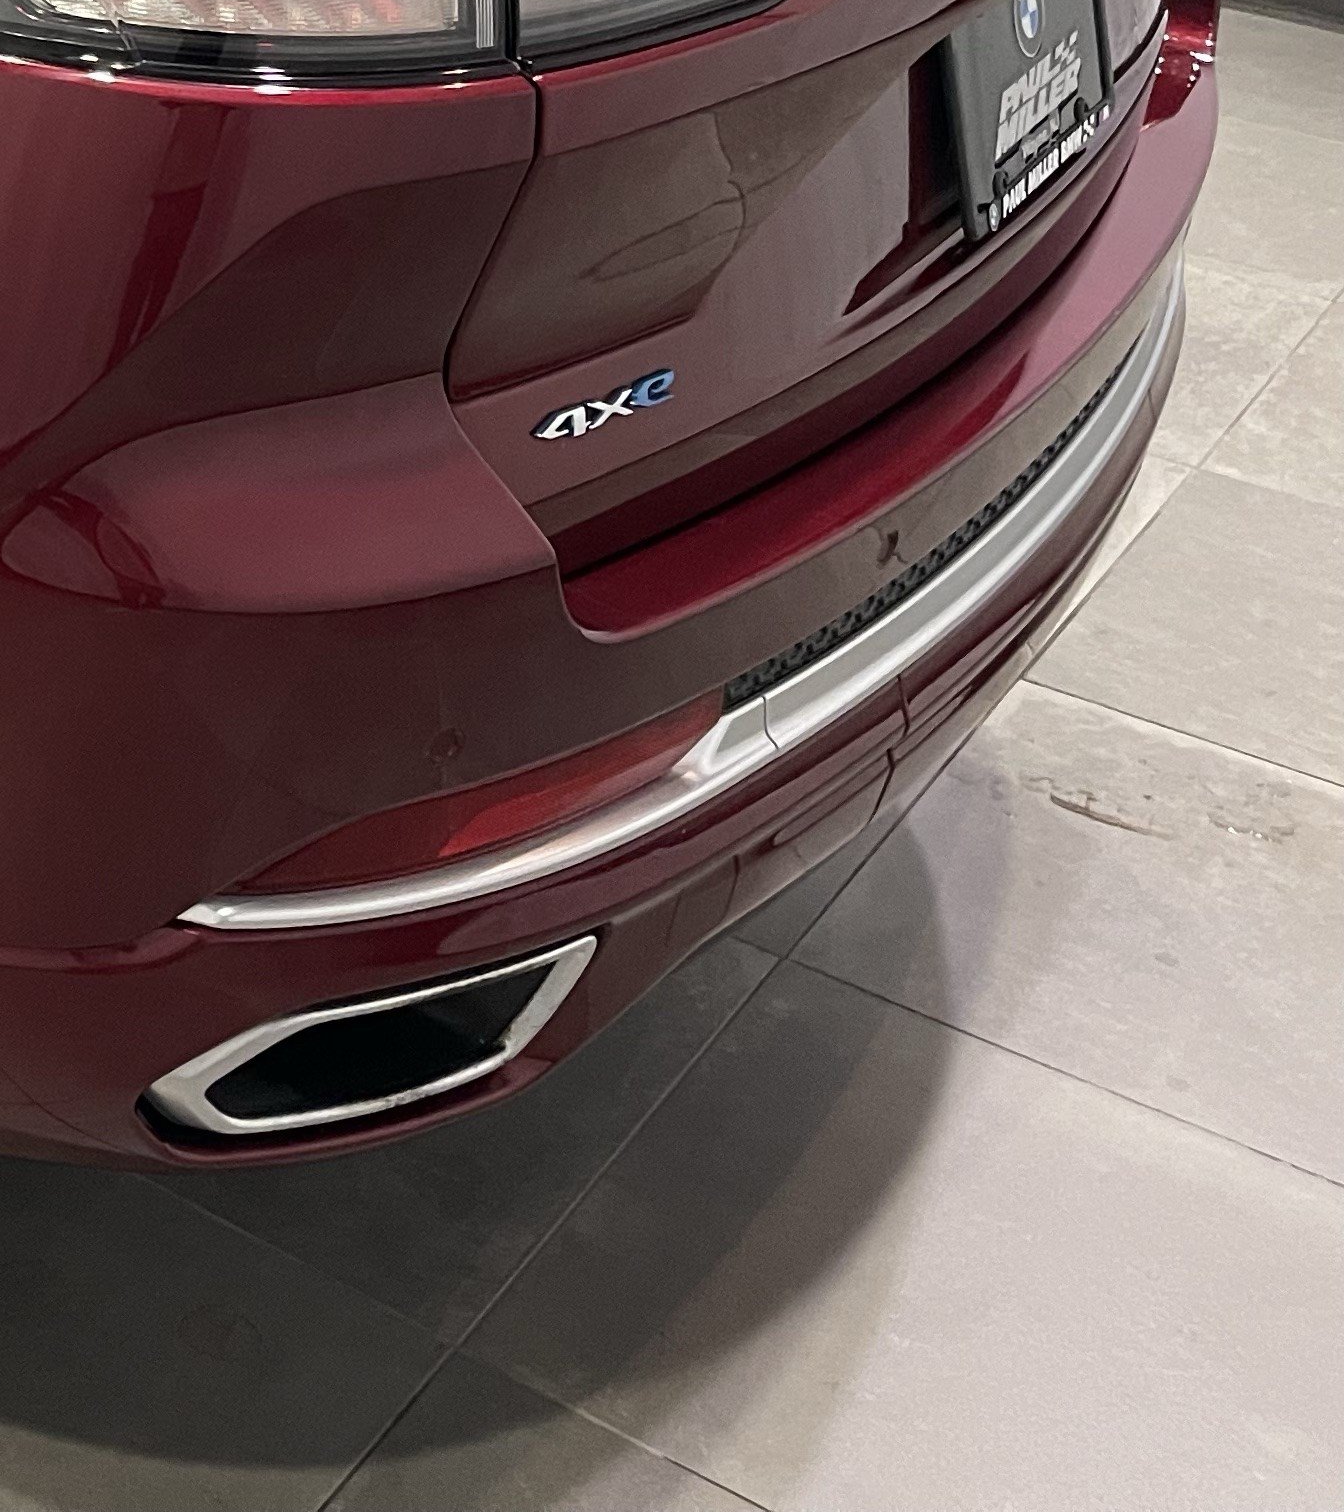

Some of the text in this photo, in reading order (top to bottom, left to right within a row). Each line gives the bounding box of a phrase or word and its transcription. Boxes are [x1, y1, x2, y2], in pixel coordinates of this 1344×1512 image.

[995, 57, 1081, 161] MILLER
[999, 52, 1062, 124] PAUL
[1002, 177, 1027, 219] PAUL
[1027, 147, 1060, 195] MILLER
